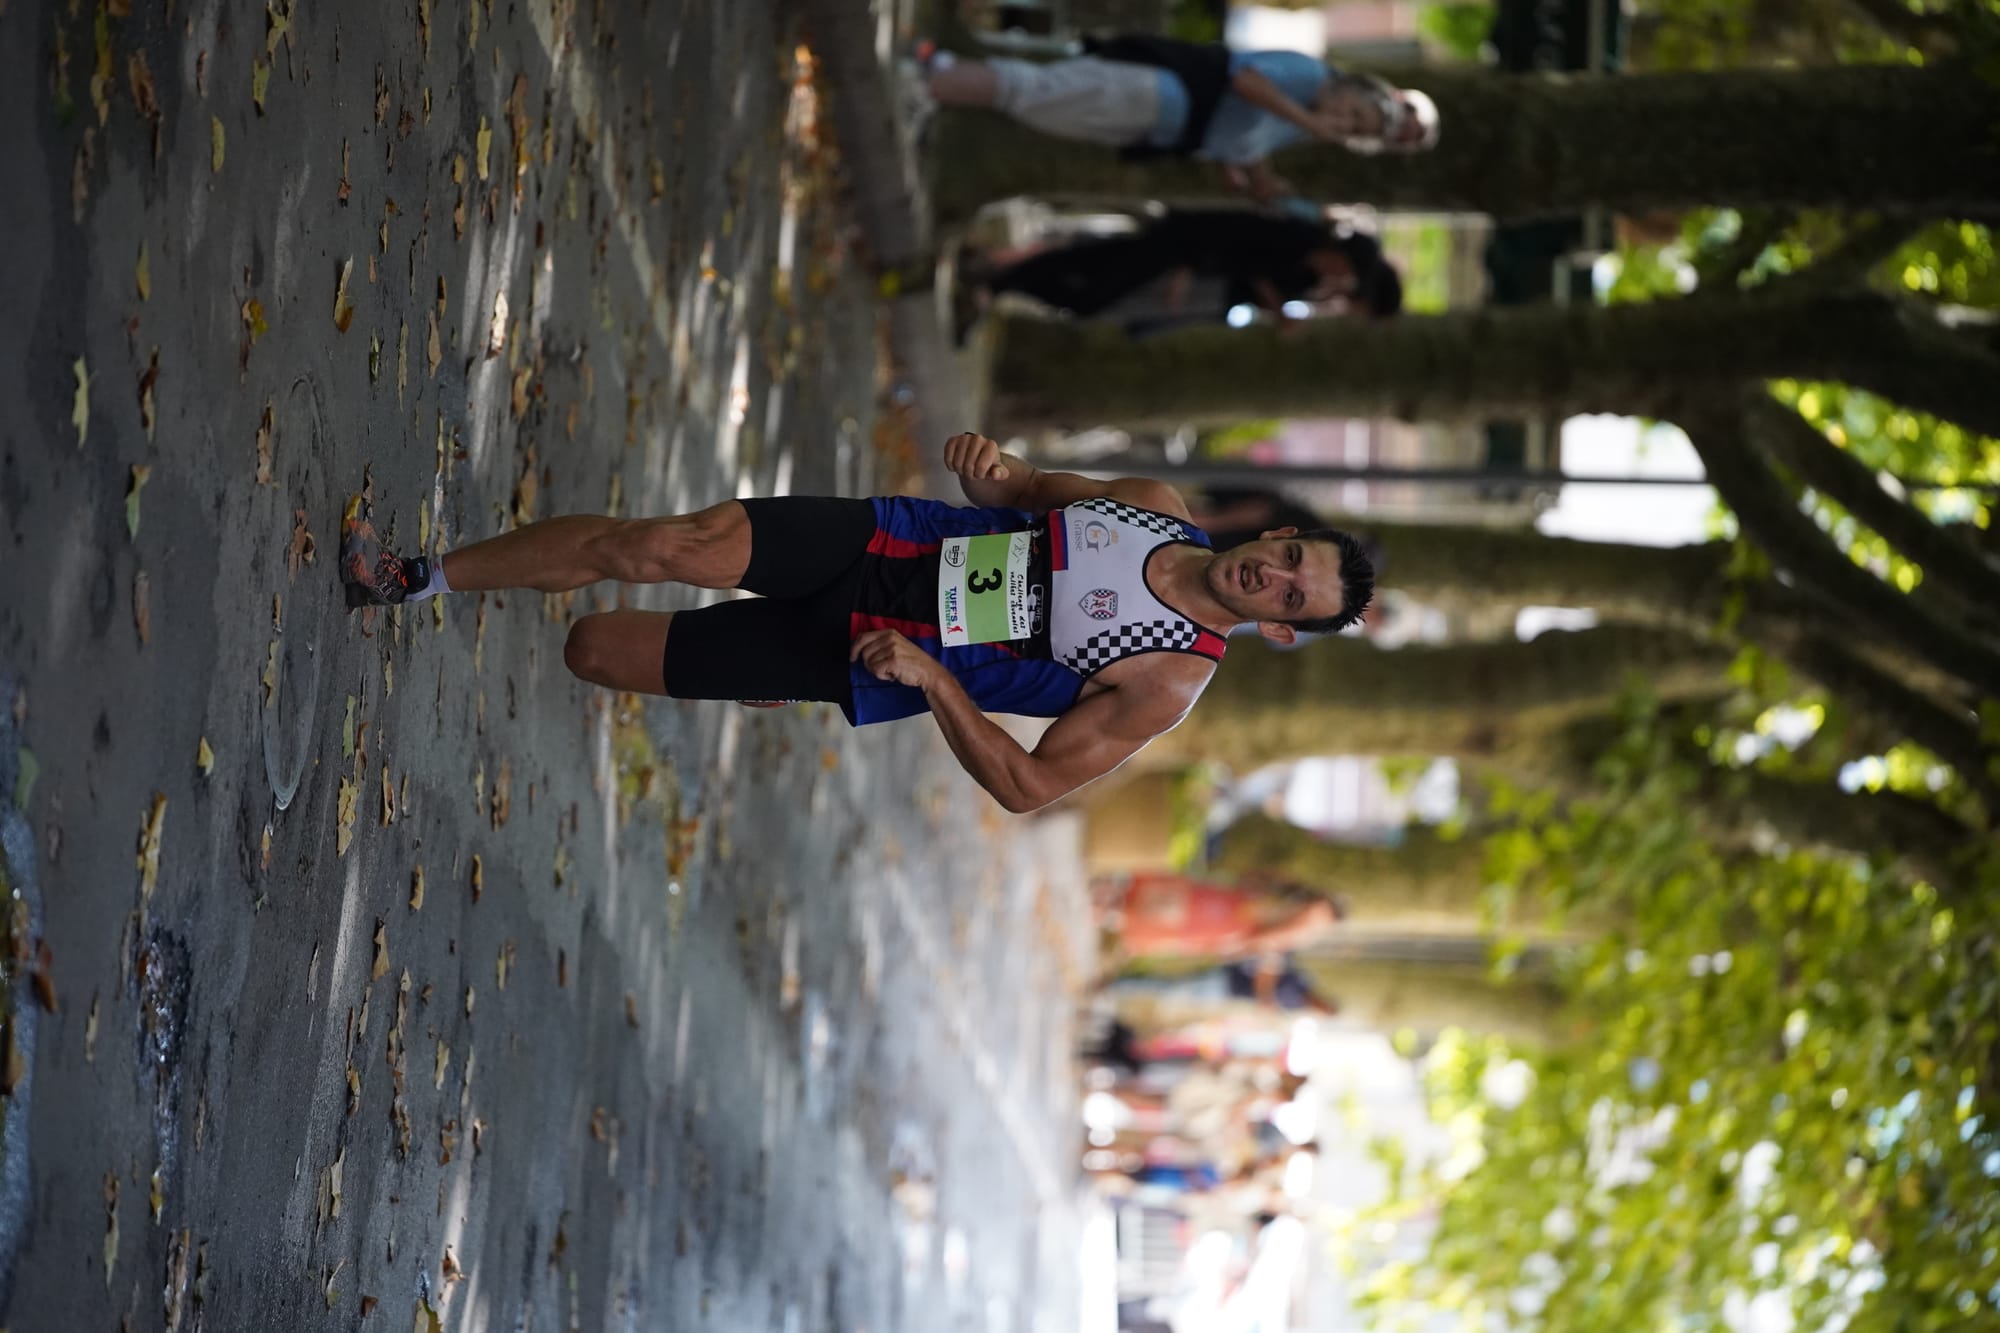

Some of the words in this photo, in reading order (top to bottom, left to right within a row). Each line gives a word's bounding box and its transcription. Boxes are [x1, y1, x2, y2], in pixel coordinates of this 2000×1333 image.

[1073, 519, 1084, 552] Grasse
[968, 567, 1003, 594] 3
[1016, 574, 1024, 611] Challenge
[950, 586, 958, 622] TUFF'S
